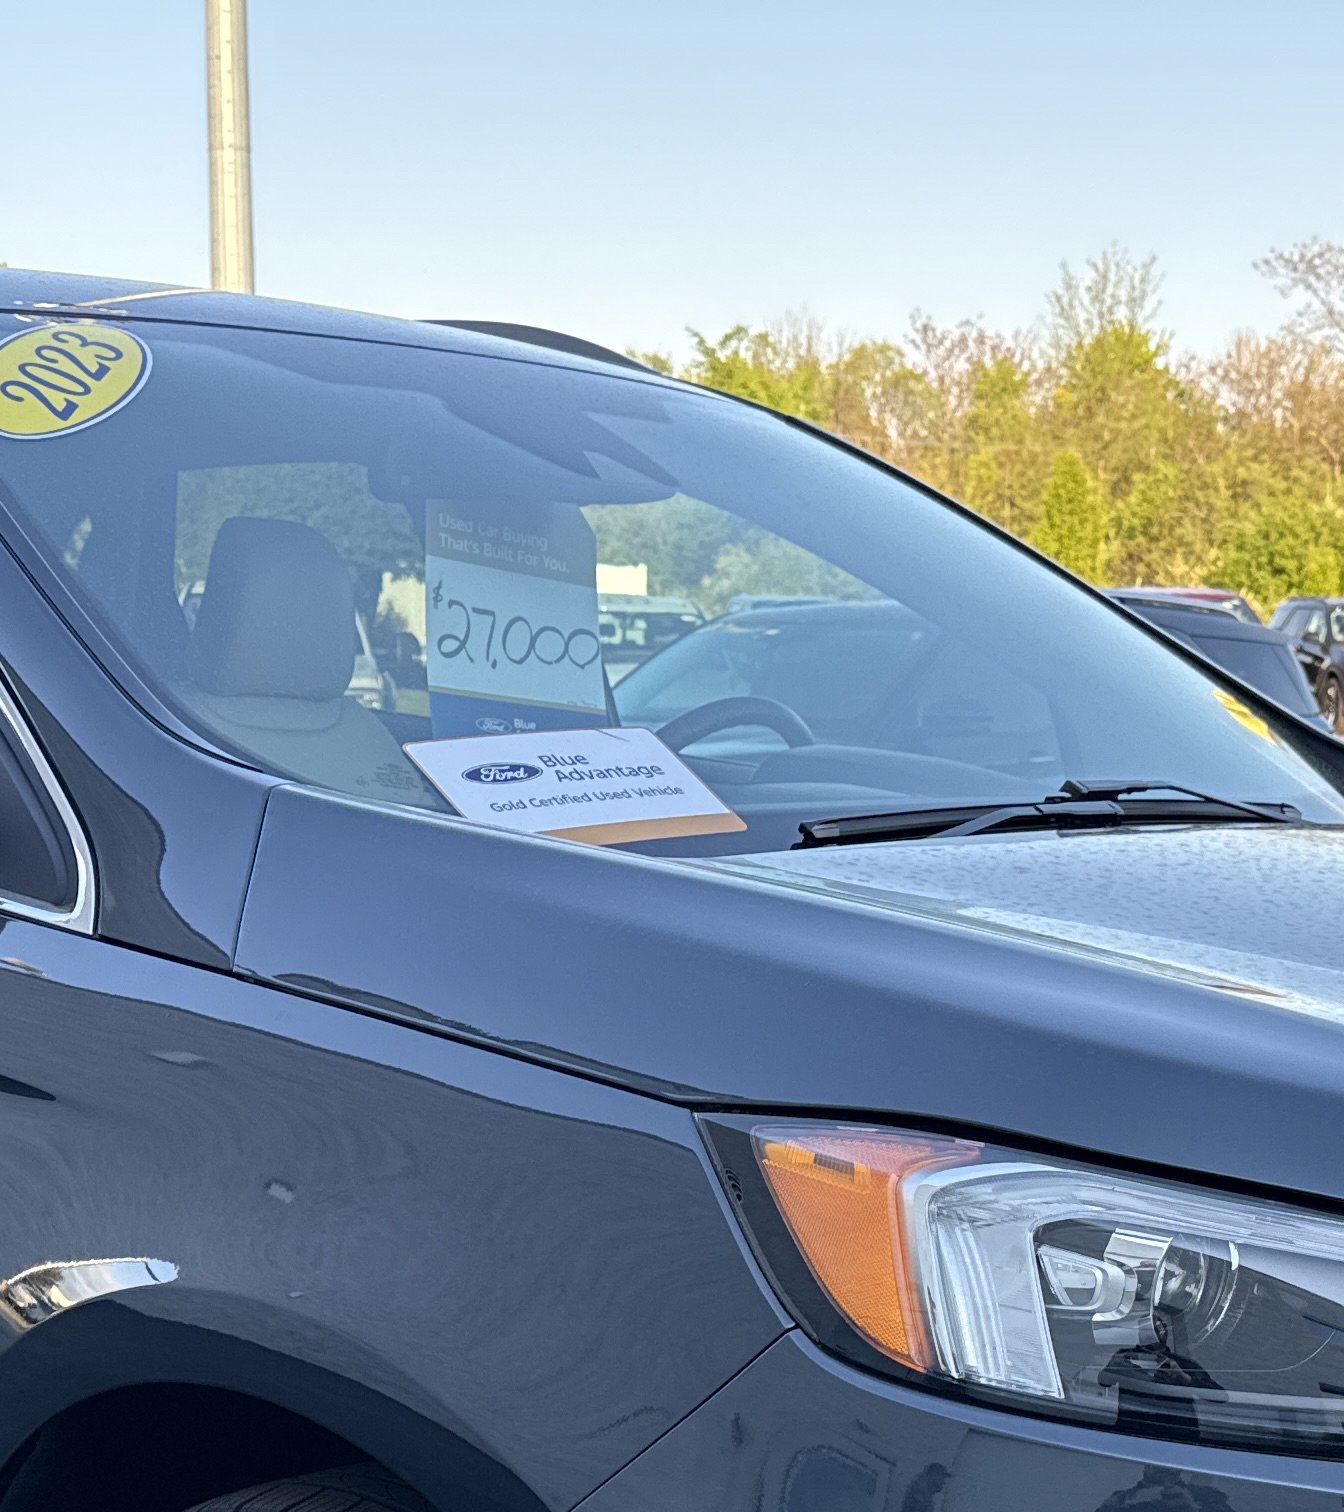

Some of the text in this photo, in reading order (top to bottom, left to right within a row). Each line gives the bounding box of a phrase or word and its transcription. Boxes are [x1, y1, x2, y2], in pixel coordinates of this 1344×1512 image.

[0, 331, 123, 421] 2023
[440, 513, 548, 550] Used Car Buying
[439, 533, 570, 573] That's Built For You.
[514, 718, 537, 731] Blue
[537, 753, 590, 768] Blue
[555, 762, 666, 783] Advantage
[489, 785, 685, 813] Gold Certified Used Vehicle
